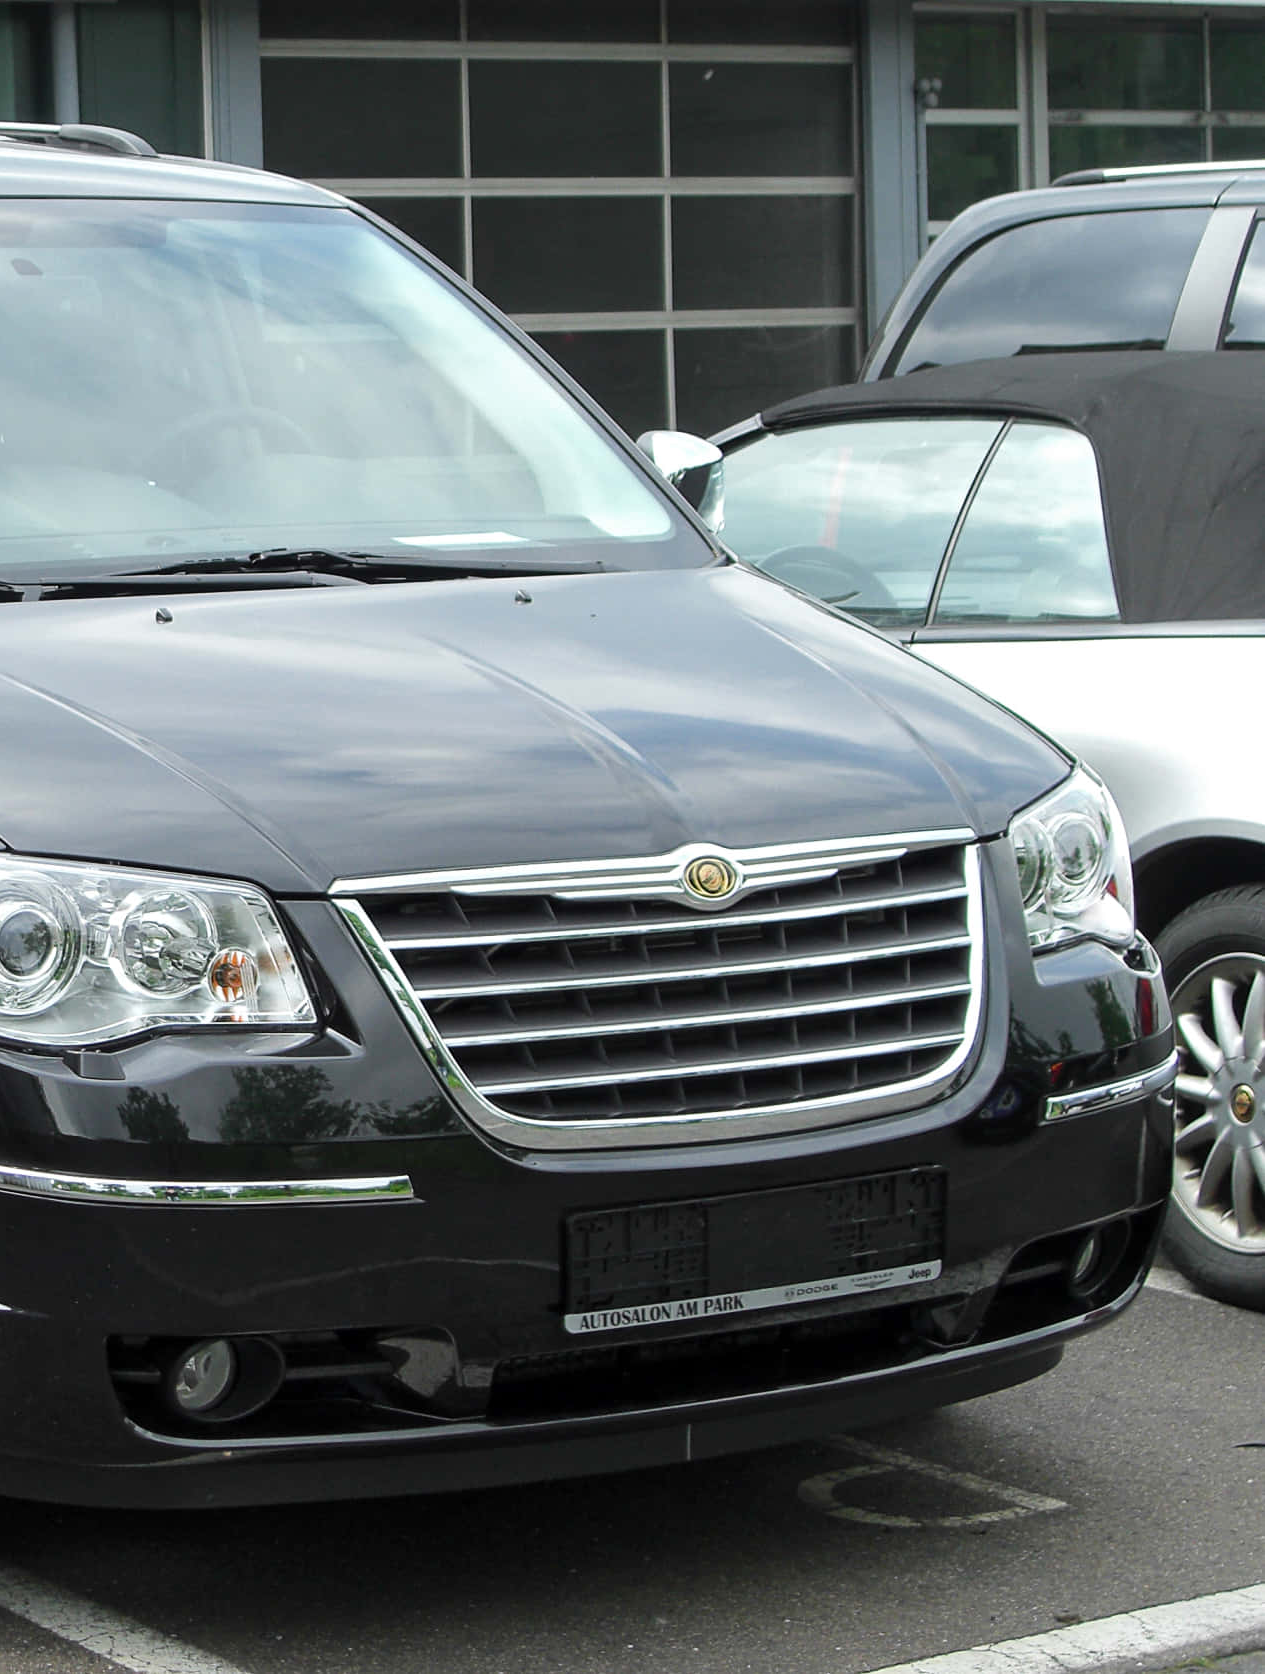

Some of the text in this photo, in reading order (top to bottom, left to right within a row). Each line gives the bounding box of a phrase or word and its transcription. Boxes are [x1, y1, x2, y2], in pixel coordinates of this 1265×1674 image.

[580, 1304, 670, 1330] AUTOSALON
[677, 1301, 698, 1317] AM
[704, 1295, 744, 1313] PARK
[796, 1283, 839, 1296] DODGE
[908, 1267, 932, 1280] Jeep
